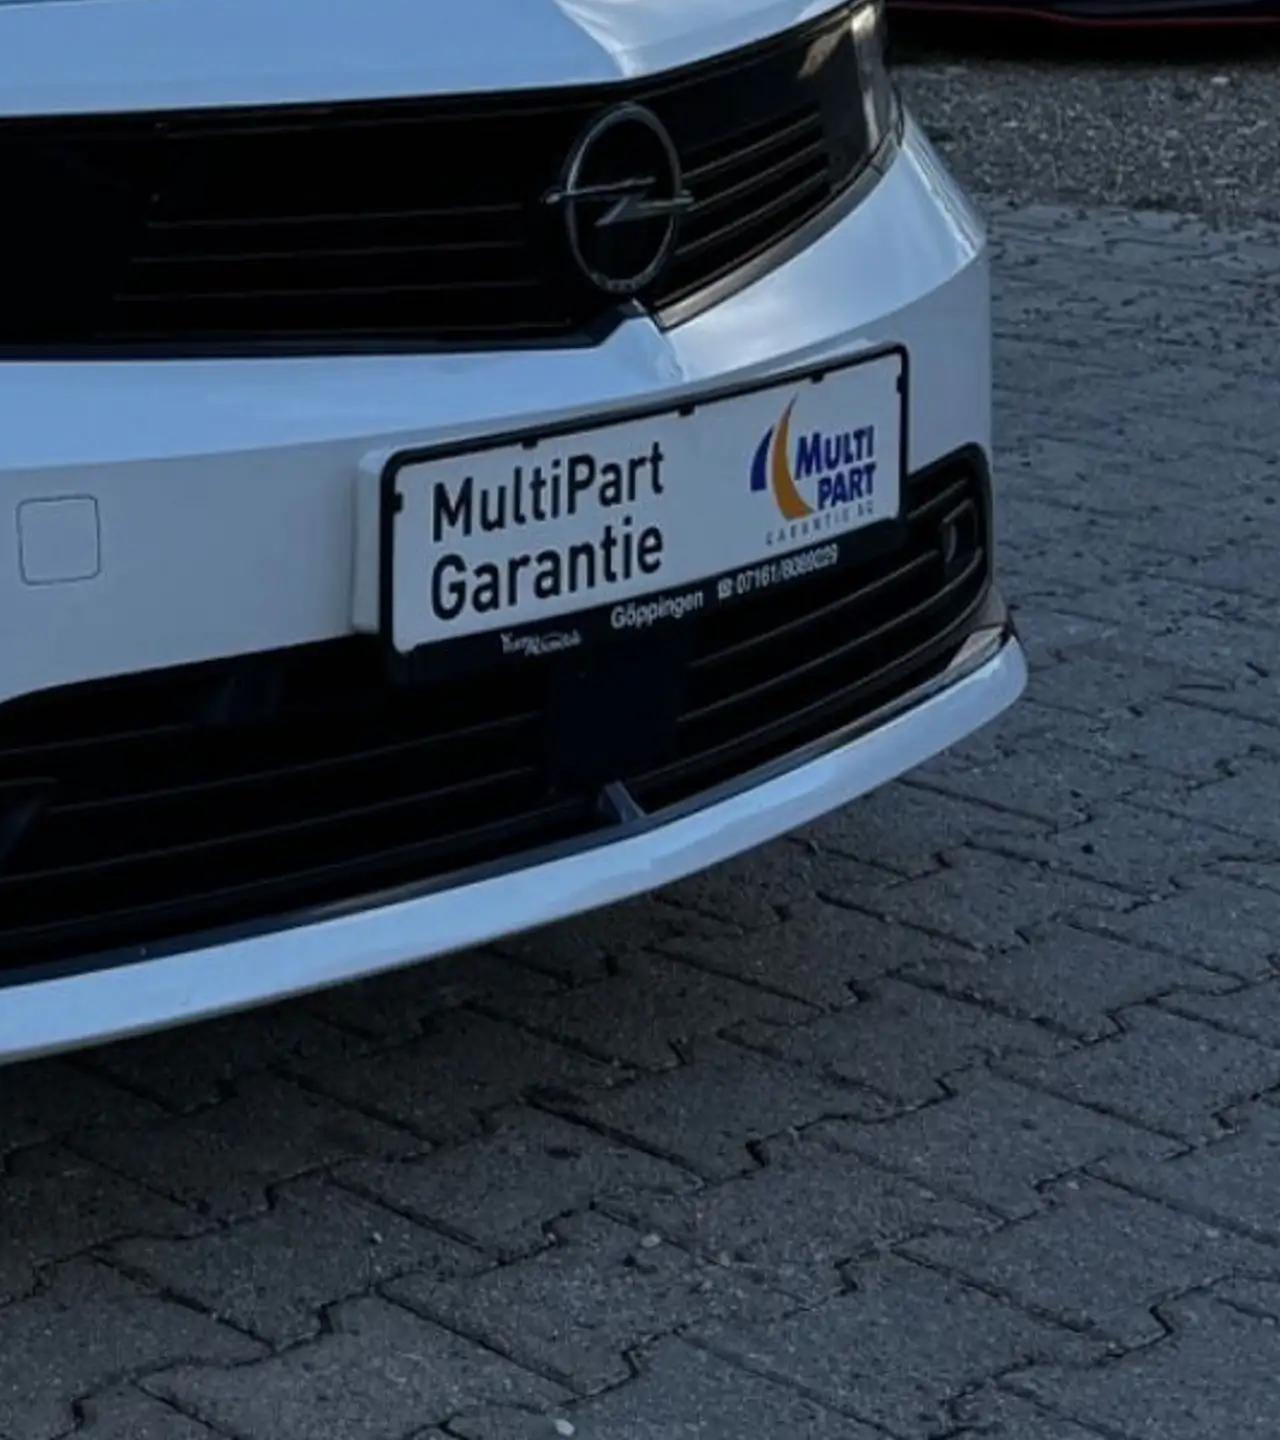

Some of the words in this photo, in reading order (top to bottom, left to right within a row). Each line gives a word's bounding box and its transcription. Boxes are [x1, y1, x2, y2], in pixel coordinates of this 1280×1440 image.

[793, 424, 875, 483] MULTI
[432, 441, 665, 543] MultiPart
[816, 461, 877, 511] PART
[431, 516, 663, 622] Garantie
[610, 590, 704, 631] Göppingen
